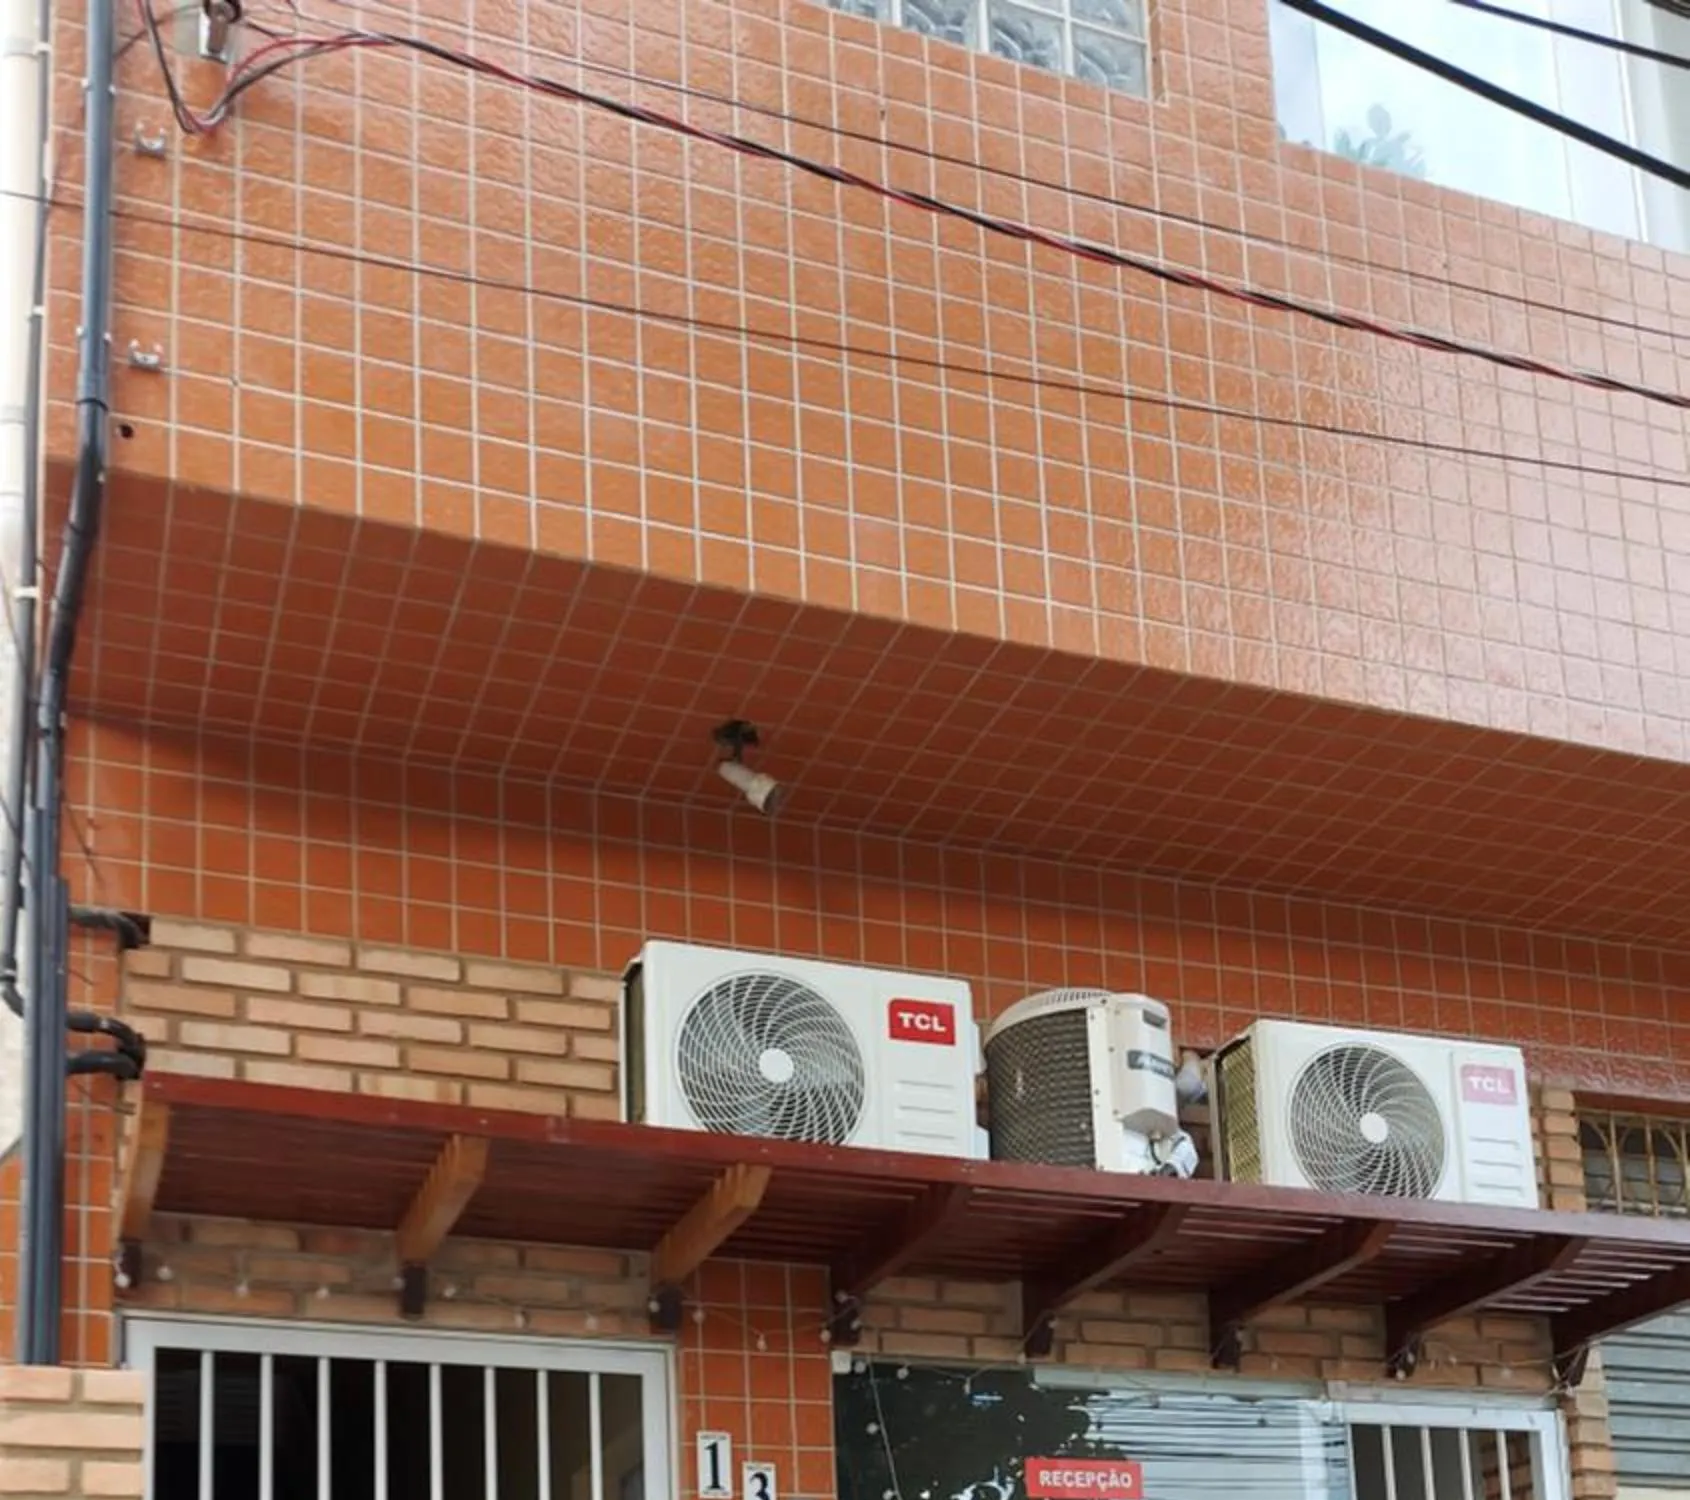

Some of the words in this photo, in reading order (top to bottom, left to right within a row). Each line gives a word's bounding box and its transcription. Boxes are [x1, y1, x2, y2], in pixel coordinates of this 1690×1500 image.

[897, 1011, 947, 1033] TCL
[1468, 1076, 1511, 1094] TCL
[1039, 1468, 1133, 1492] RECEPÇÃO
